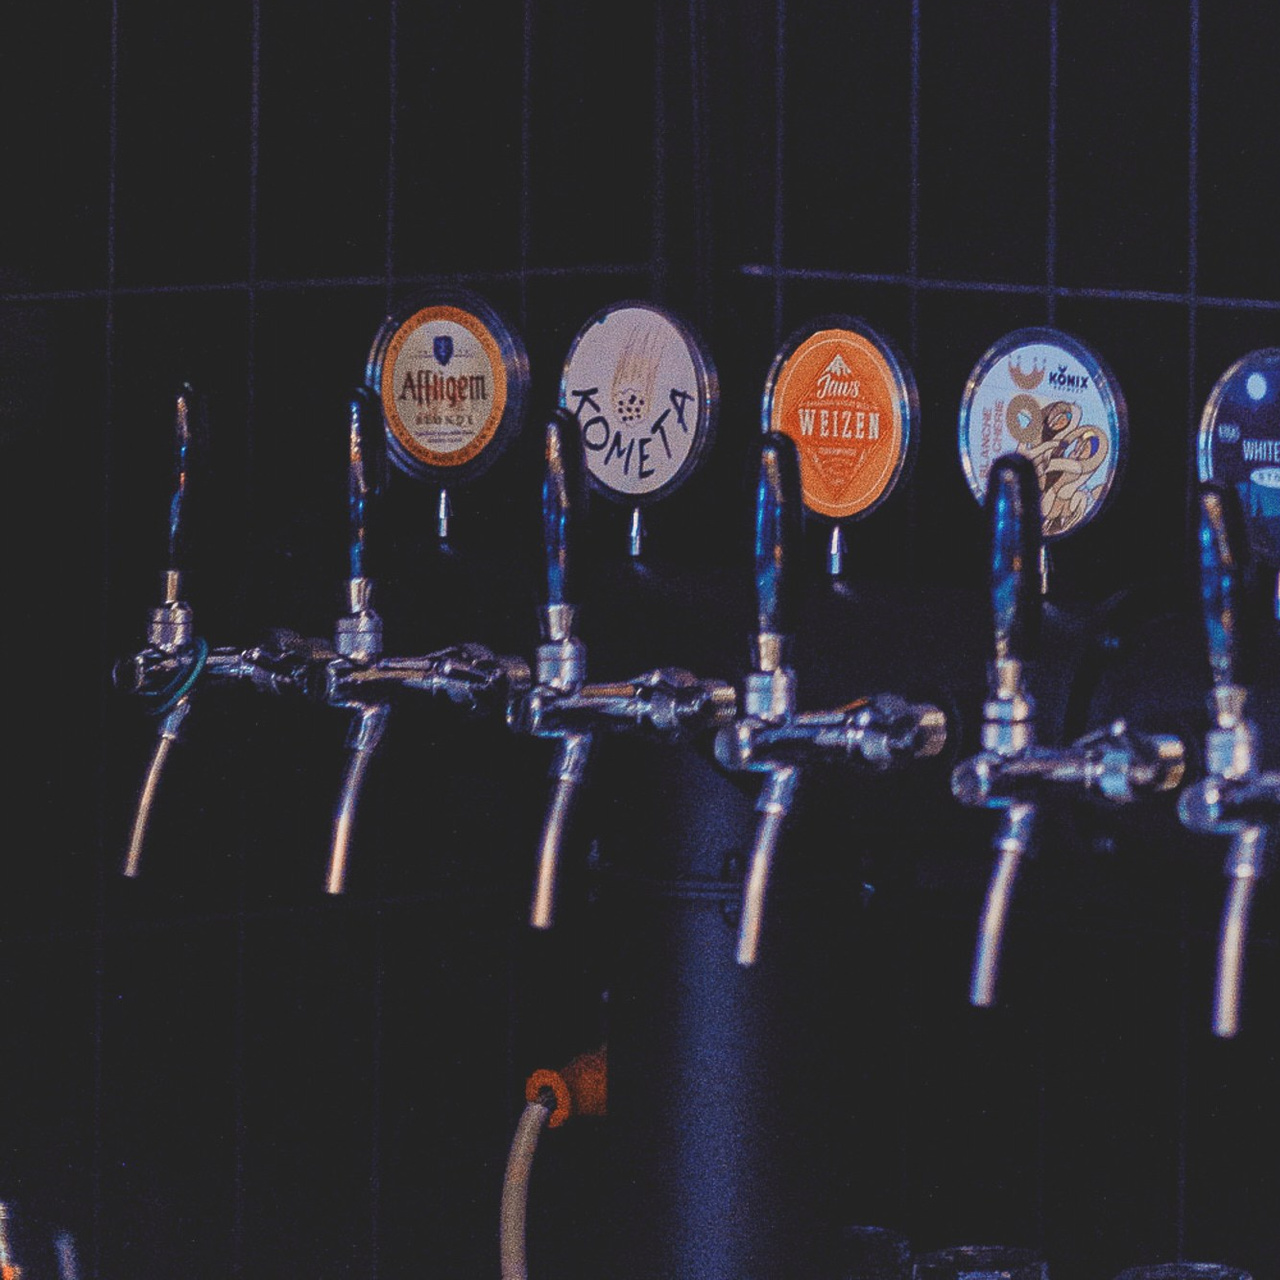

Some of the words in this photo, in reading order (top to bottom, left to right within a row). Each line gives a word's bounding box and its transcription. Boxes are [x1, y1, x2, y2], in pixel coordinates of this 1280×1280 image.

[400, 369, 488, 407] Affligem
[816, 374, 861, 399] Jaws
[572, 387, 695, 479] KOMETA
[798, 407, 881, 440] WEIZEN
